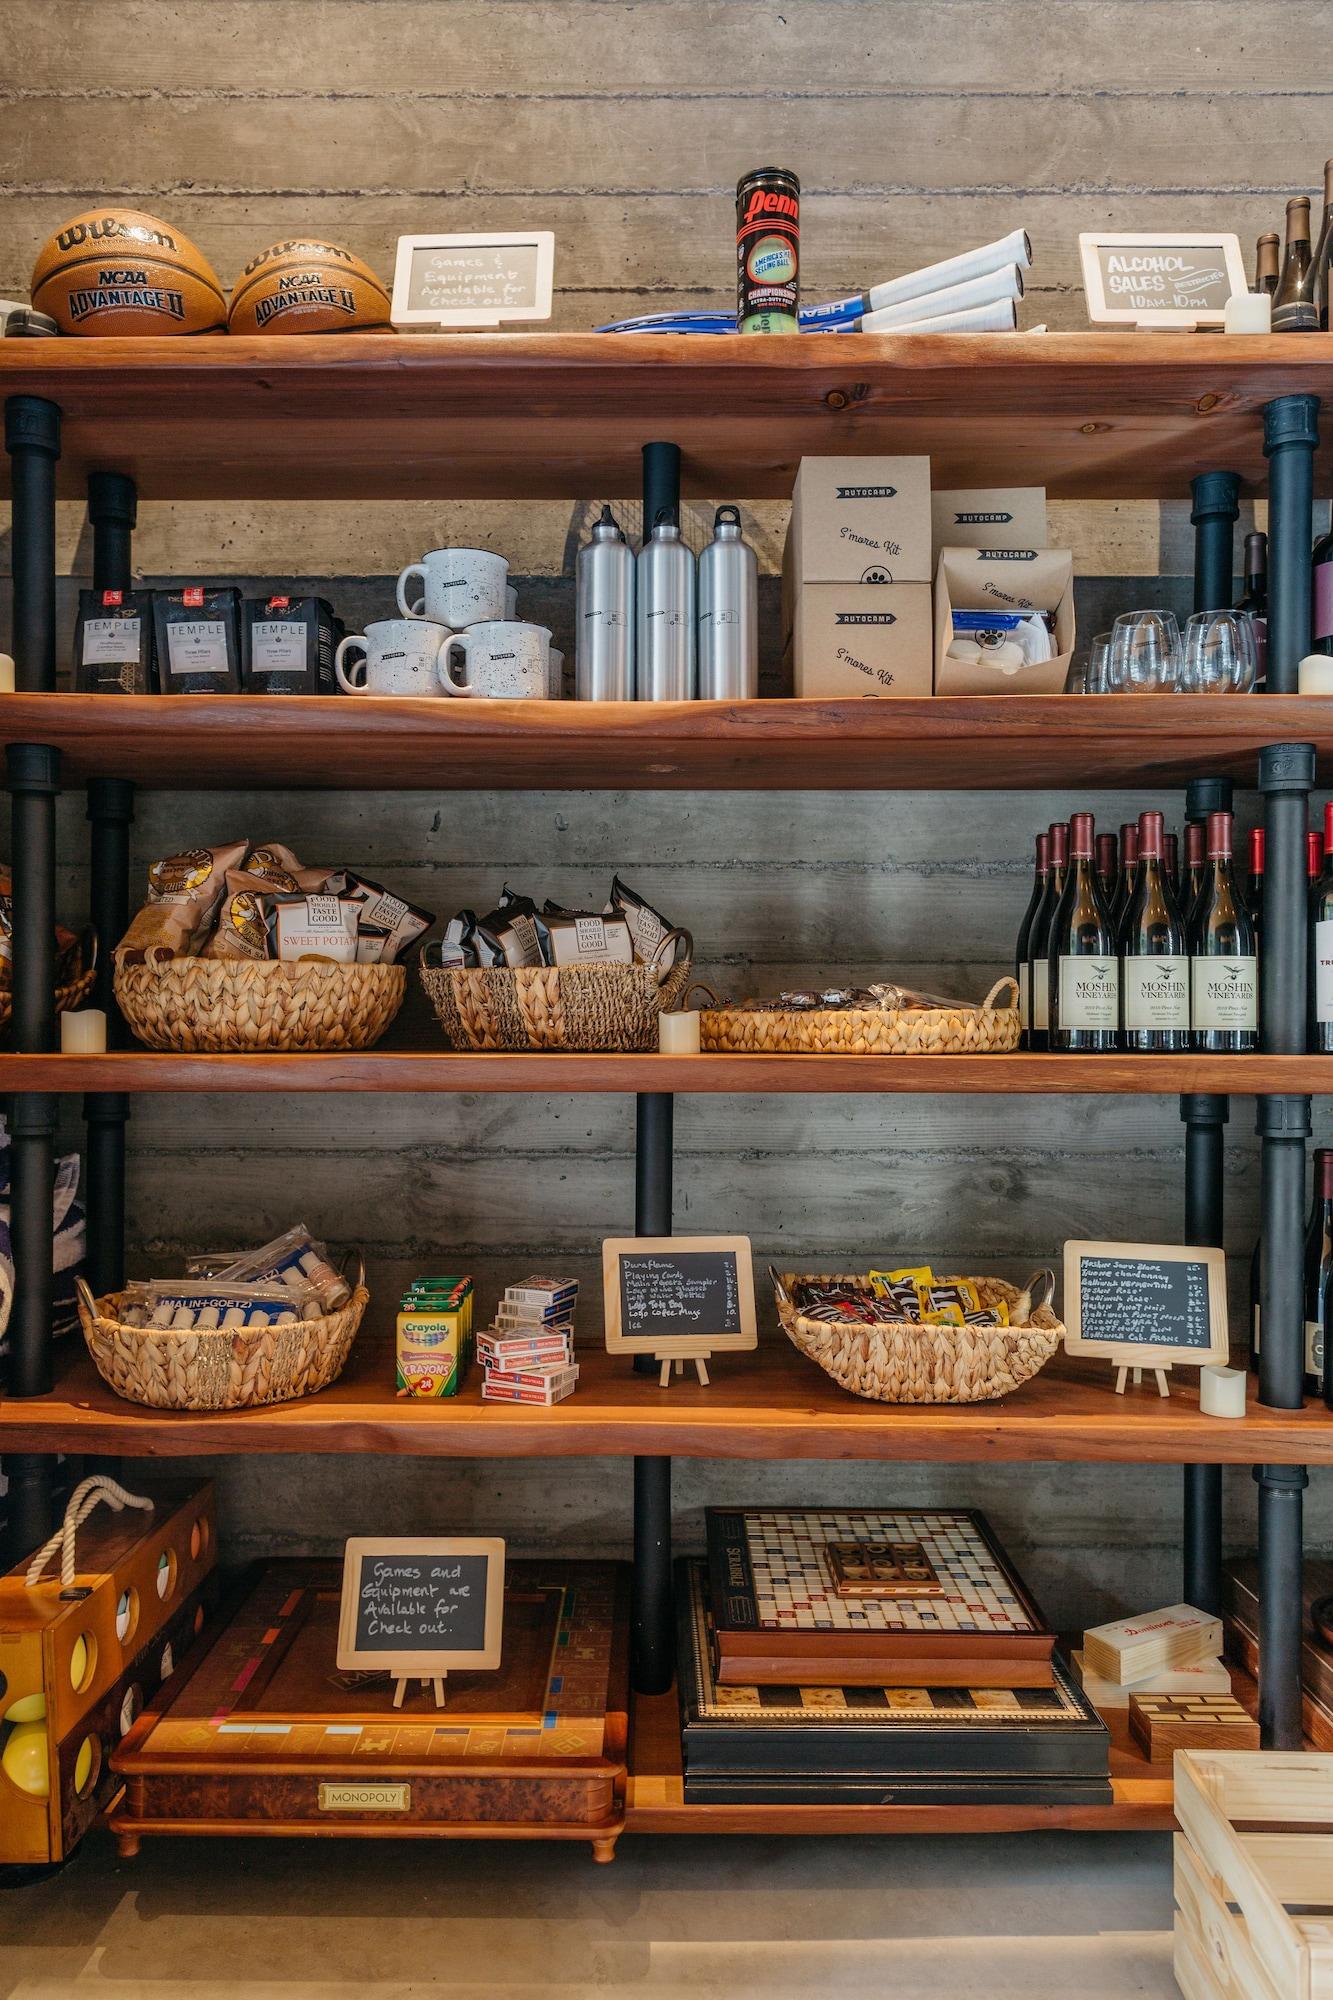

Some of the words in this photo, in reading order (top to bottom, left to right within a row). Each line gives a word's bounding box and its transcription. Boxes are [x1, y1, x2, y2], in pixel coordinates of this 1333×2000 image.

[55, 217, 177, 251] Wilson
[245, 241, 354, 275] Wilson
[432, 257, 483, 268] Games
[1107, 256, 1195, 273] ALCOHOL
[754, 260, 776, 275] SELLING
[776, 258, 789, 267] BALL
[99, 271, 147, 285] NCAA
[280, 272, 321, 290] NCAA
[424, 270, 518, 283] Equipment
[421, 284, 495, 296] Available
[502, 283, 526, 297] for
[1109, 276, 1167, 294] SALES
[748, 287, 797, 301] CHAMPIONSHIP
[69, 289, 166, 320] ADVANTAGE
[255, 289, 338, 328] ADVANTAGE
[844, 488, 892, 497] AUTOCAMP
[962, 513, 1008, 522] AUTOCAMP
[840, 527, 880, 549] S'mores
[883, 540, 902, 556] Kit
[985, 550, 1033, 559] AUTOCAMP
[982, 582, 1016, 603] S'mores
[843, 615, 892, 623] AUTOCAMP
[87, 621, 139, 631] TEMPLE
[170, 625, 223, 635] TEMPLE
[255, 625, 305, 635] TEMPLE
[837, 648, 874, 676] S'mores
[877, 669, 895, 686] Kit
[386, 895, 406, 911] FOOD
[374, 912, 396, 926] GOOD
[378, 906, 399, 920] TASTE
[579, 919, 601, 928] FOOD
[283, 936, 319, 945] SWEET
[581, 933, 602, 941] TASTE
[581, 940, 603, 949] GOOD
[1076, 982, 1117, 992] MOSHIN
[1141, 982, 1186, 992] MOSHIN
[1207, 982, 1254, 992] MOSHIN
[624, 1271, 659, 1281] Playing
[405, 1322, 448, 1333] Crayola
[403, 1364, 449, 1377] CRAYONS
[420, 1379, 433, 1389] 24
[374, 1562, 421, 1587] Games
[430, 1565, 461, 1579] and
[361, 1582, 440, 1601] Equipment
[449, 1585, 471, 1597] are
[364, 1601, 426, 1619] Available
[433, 1598, 459, 1619] for
[367, 1619, 412, 1636] Check
[419, 1621, 453, 1635] out.
[331, 1792, 397, 1803] MONOPOLY
